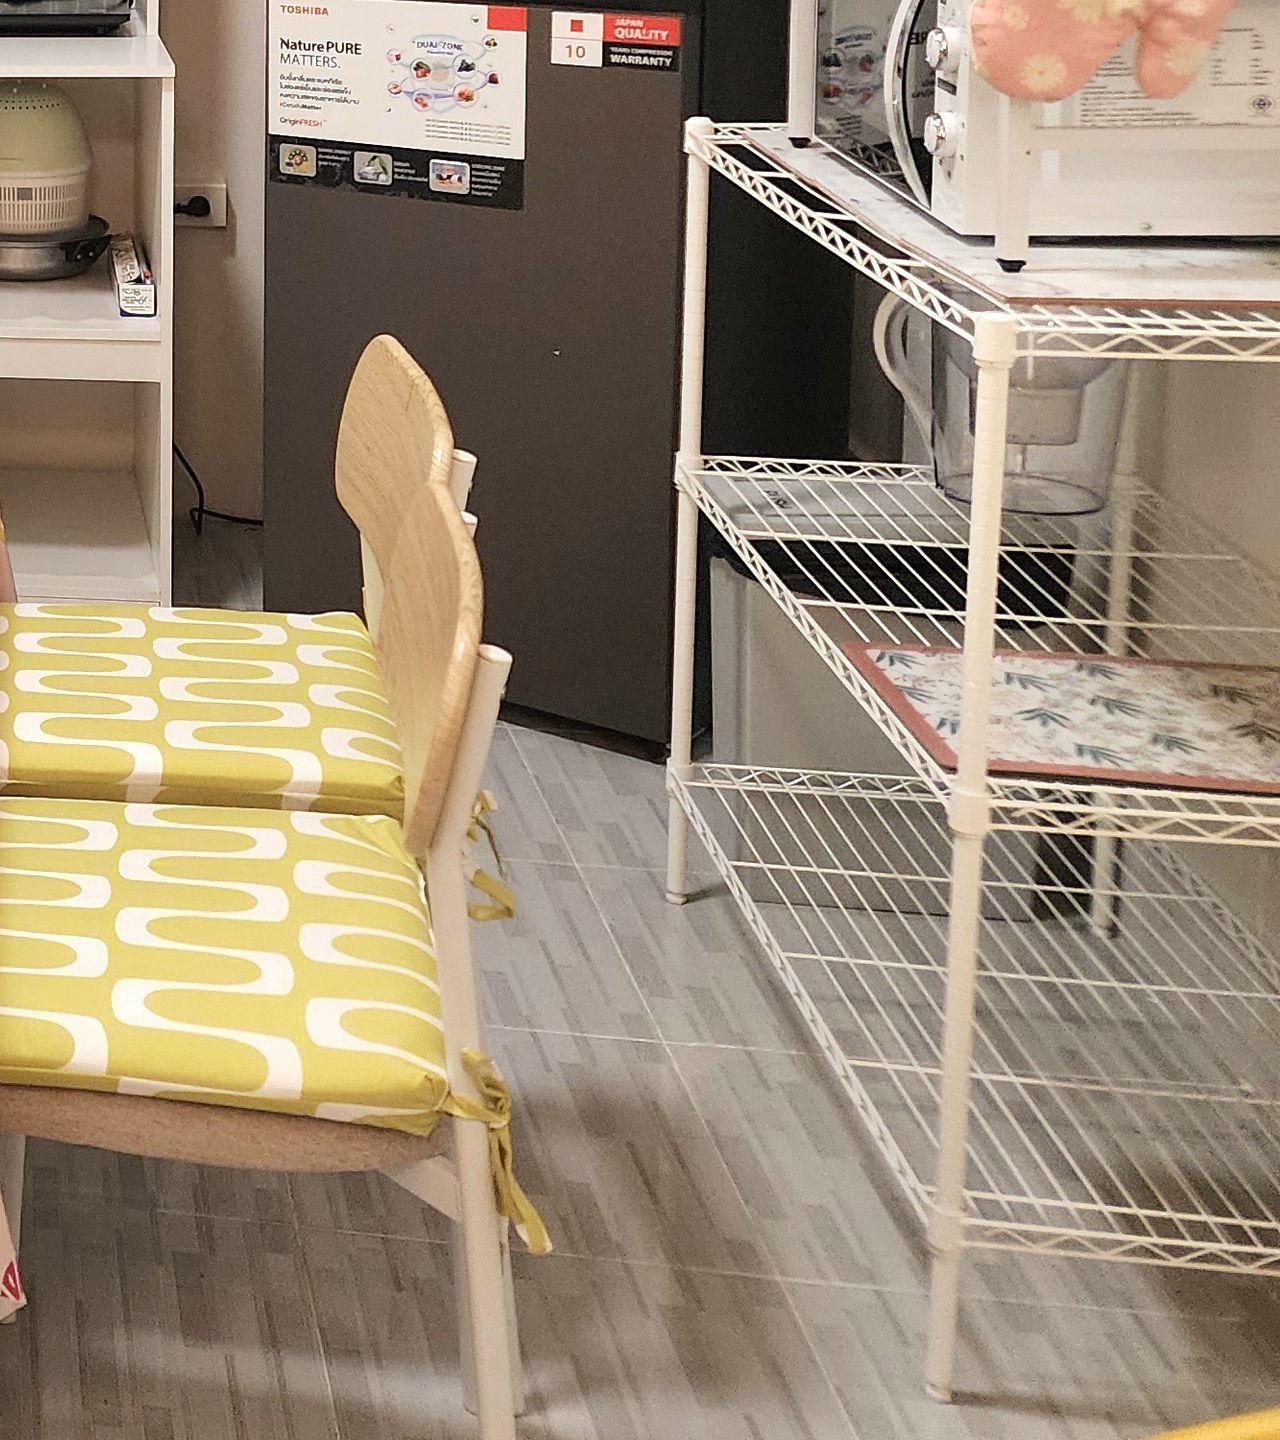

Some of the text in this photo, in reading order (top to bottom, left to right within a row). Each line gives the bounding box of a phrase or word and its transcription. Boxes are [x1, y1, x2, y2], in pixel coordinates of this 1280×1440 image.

[280, 5, 329, 16] TOSHIBA
[614, 18, 644, 28] JAPAN
[615, 27, 670, 41] QUALITY
[565, 45, 586, 58] 10
[280, 53, 341, 68] MATTERS.
[609, 54, 672, 67] WARRANTY
